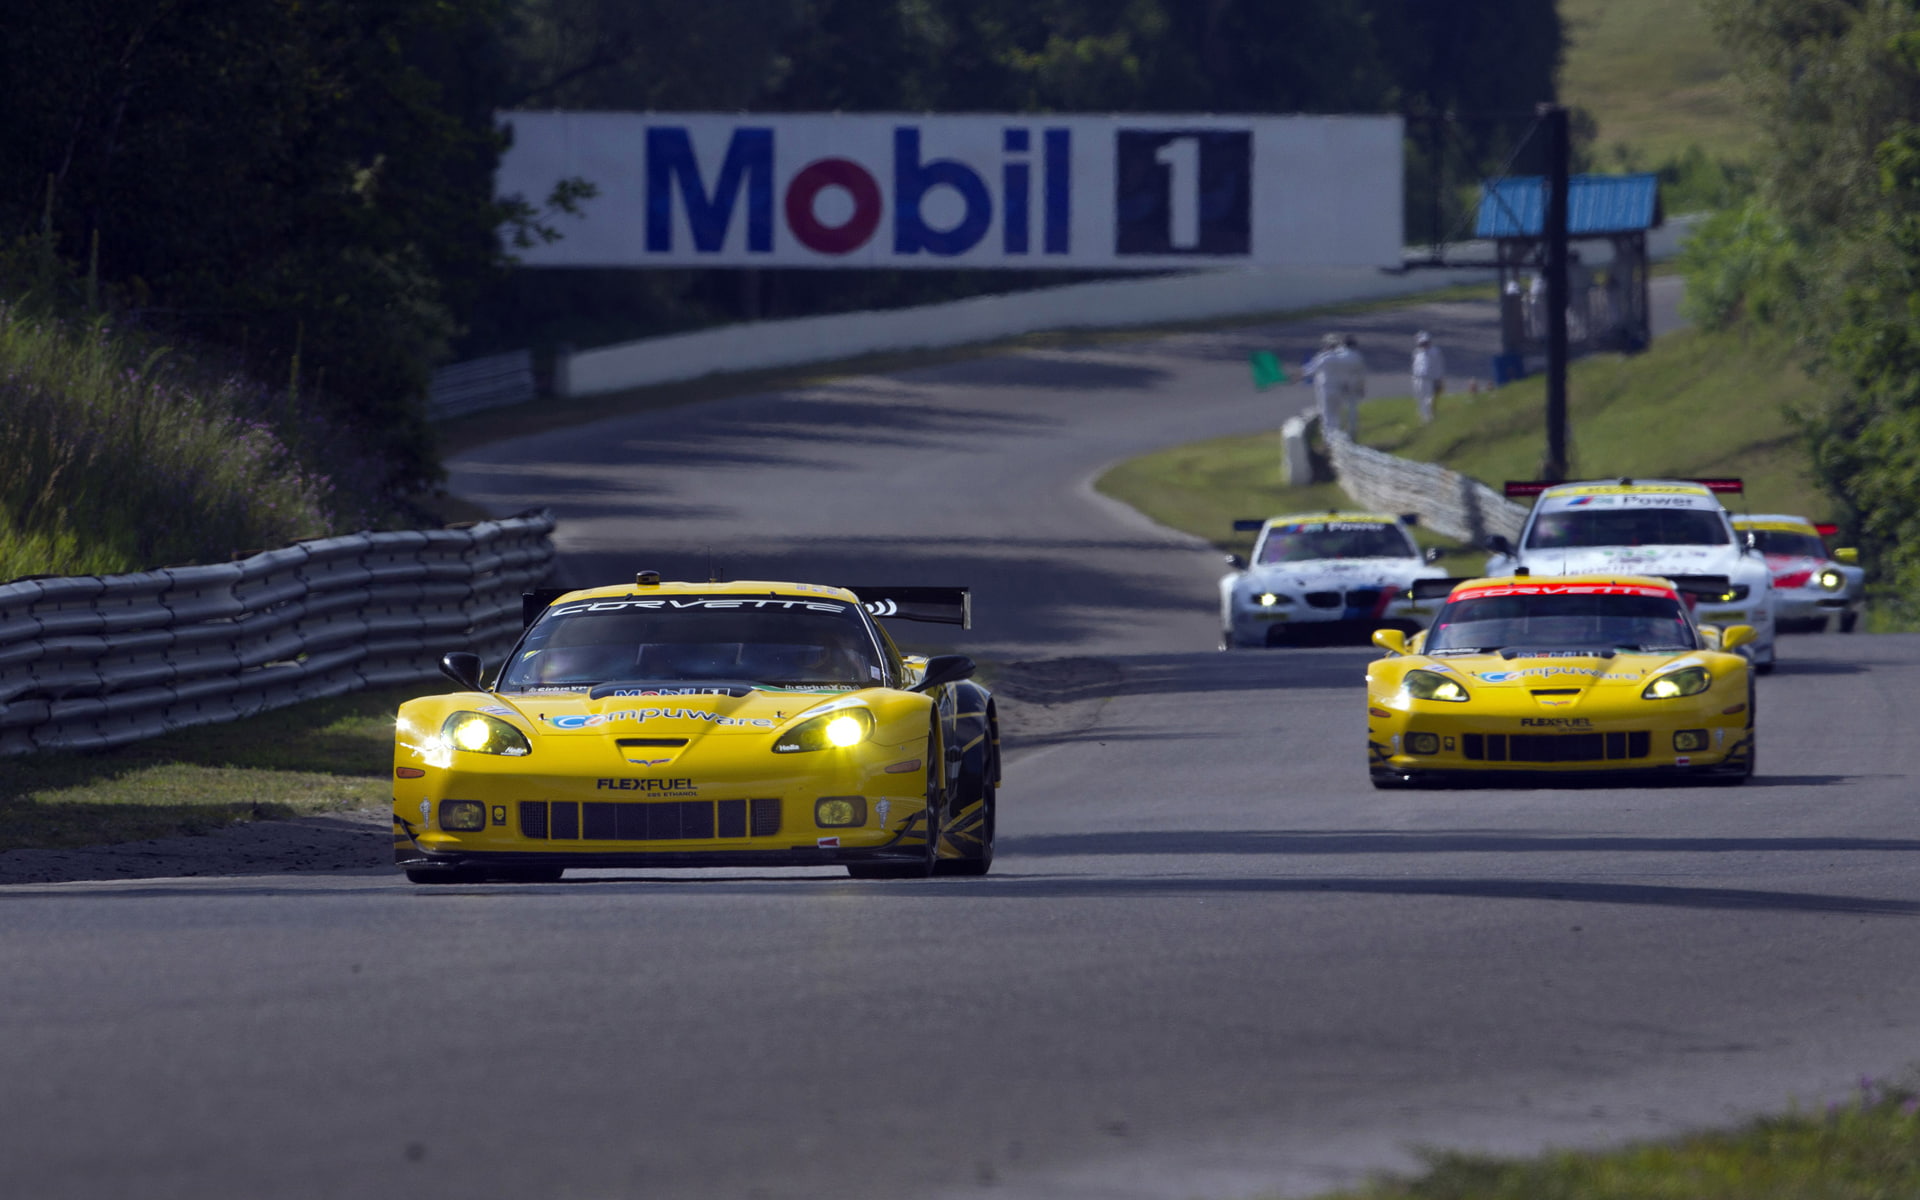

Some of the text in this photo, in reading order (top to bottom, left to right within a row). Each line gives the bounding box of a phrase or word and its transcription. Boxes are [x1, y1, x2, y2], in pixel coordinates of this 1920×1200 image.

[644, 127, 1199, 257] Mobil 1
[1456, 586, 1668, 600] CORVETTE
[551, 599, 846, 616] CORVETTE
[1484, 665, 1641, 683] Compuware
[614, 688, 696, 697] Mobil
[555, 707, 773, 728] Compuware
[597, 778, 698, 791] FLEXFUEL
